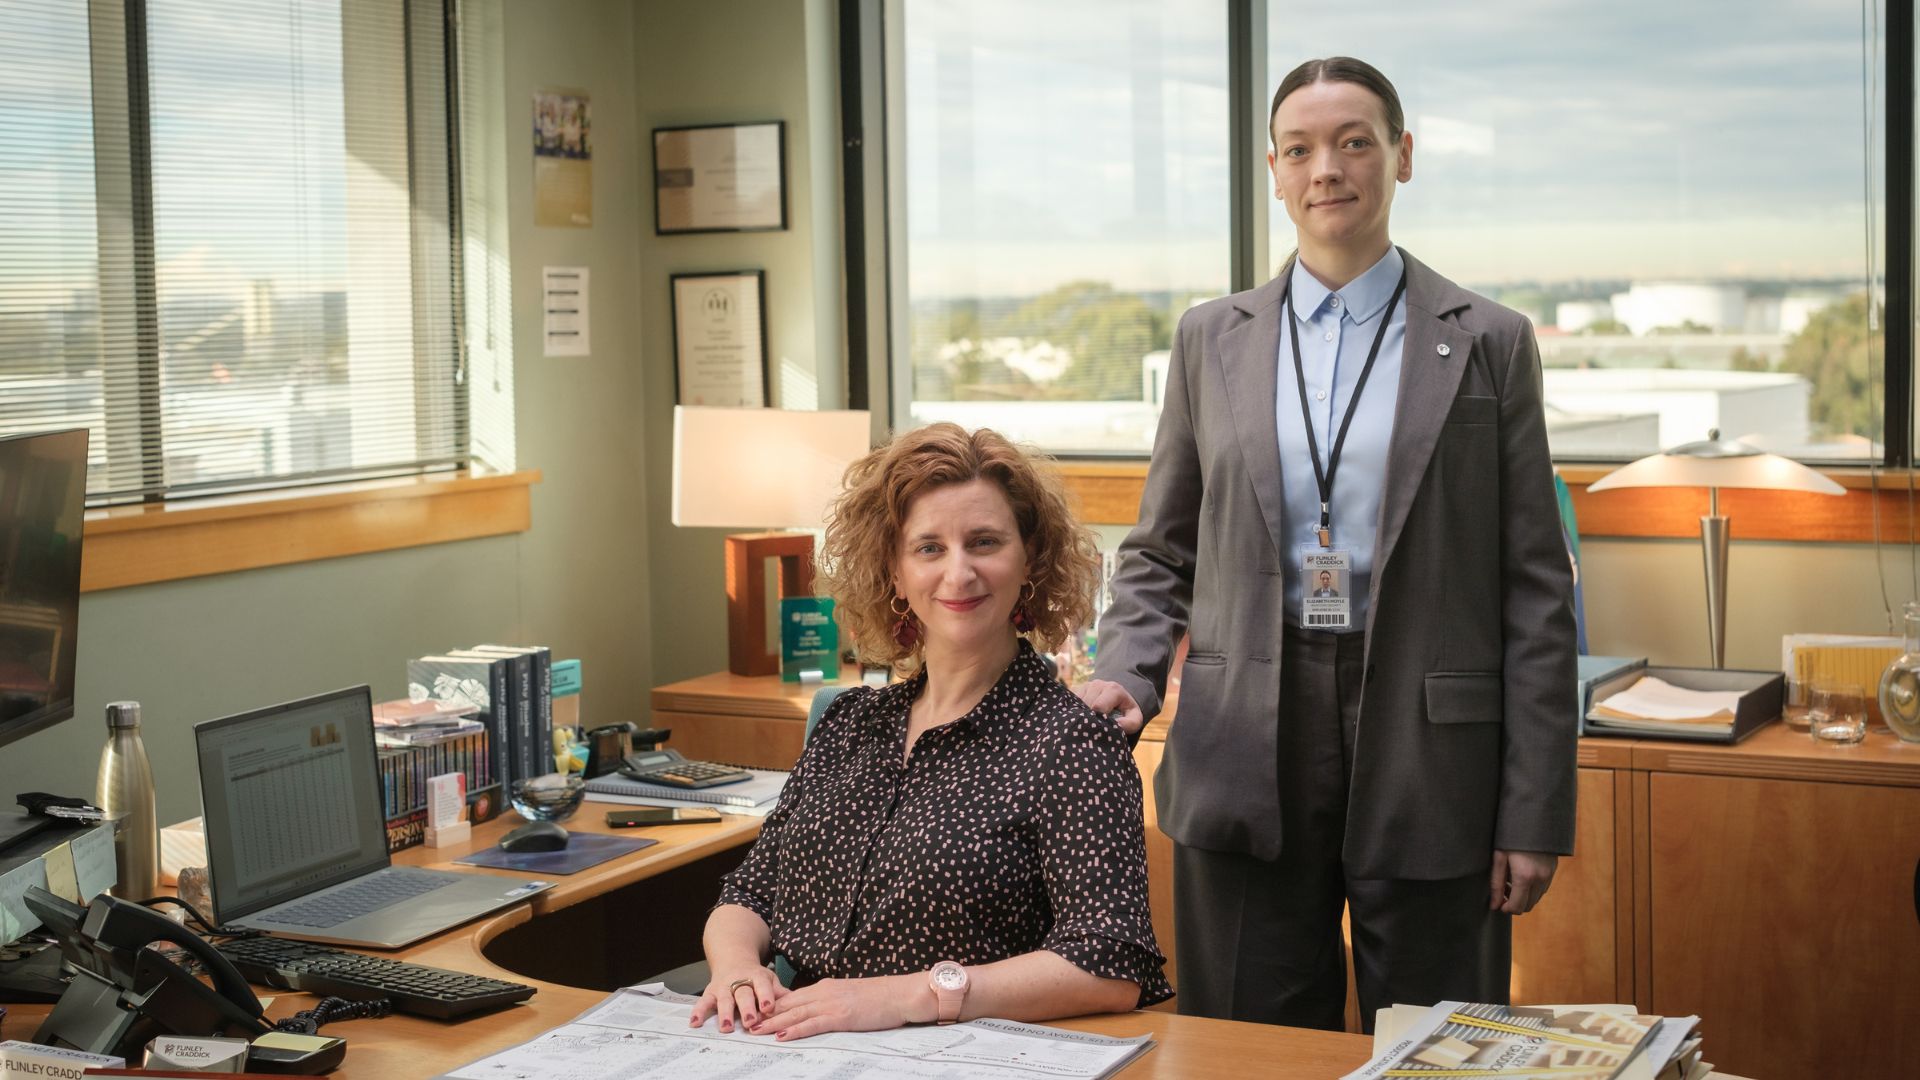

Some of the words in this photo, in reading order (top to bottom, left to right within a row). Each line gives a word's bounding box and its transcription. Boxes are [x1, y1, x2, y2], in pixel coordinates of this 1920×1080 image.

[1047, 1031, 1085, 1040] TODAY
[5, 1059, 45, 1077] FLINLEY
[46, 1065, 83, 1080] CRADD
